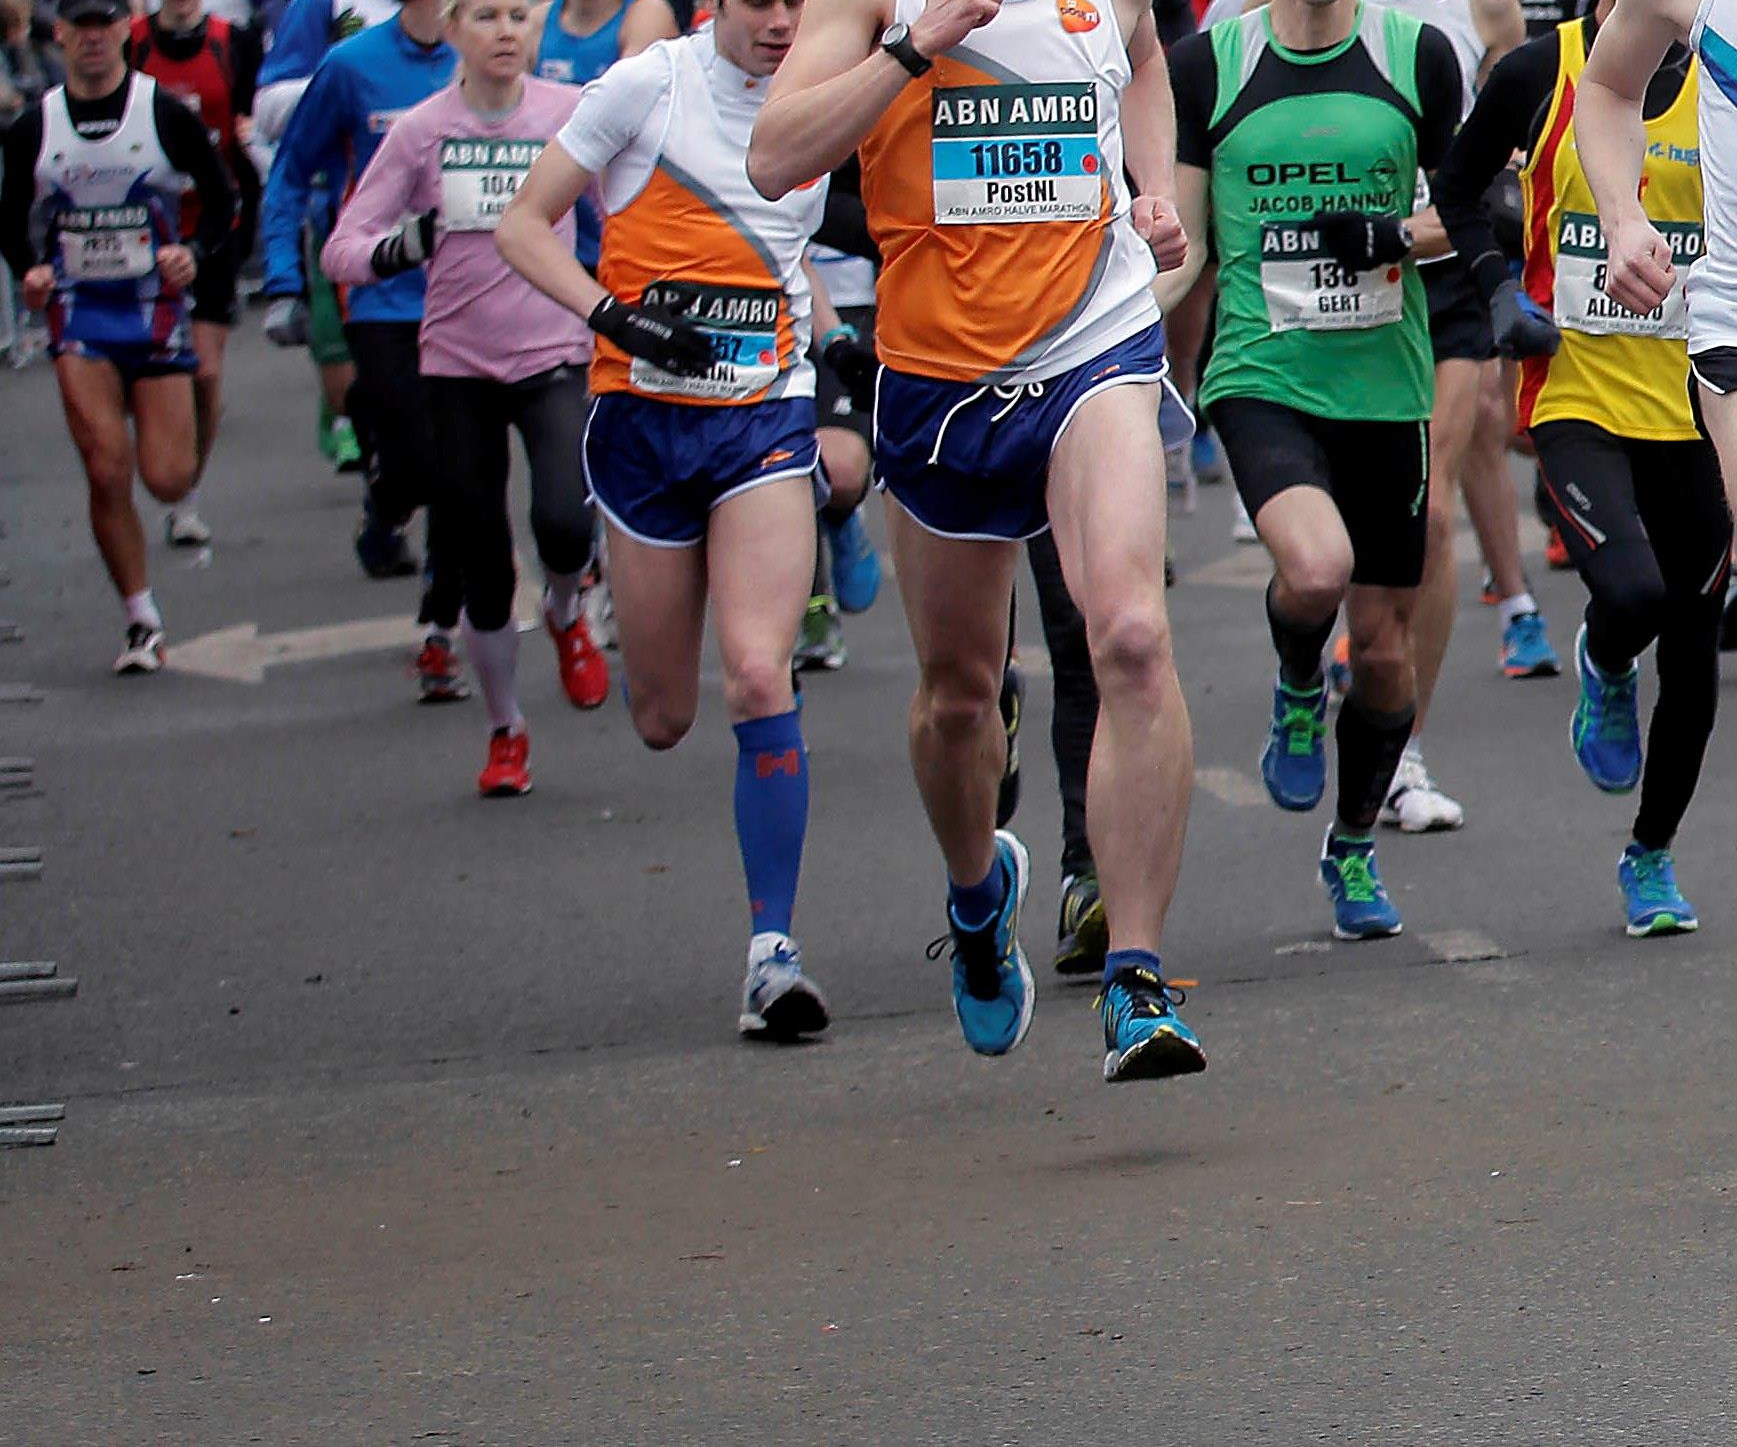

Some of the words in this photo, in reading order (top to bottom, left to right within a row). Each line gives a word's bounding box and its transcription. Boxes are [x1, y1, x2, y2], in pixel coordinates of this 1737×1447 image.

[934, 96, 1000, 126] ABN
[1009, 94, 1095, 124] AMRO
[443, 144, 488, 165] ABN
[493, 143, 544, 164] AMR
[969, 140, 1063, 177] 11658
[479, 174, 522, 194] 104
[1246, 162, 1361, 186] OPEL
[986, 179, 1058, 204] PostNL
[947, 207, 970, 218] ABN
[971, 206, 1003, 217] AMRO
[1004, 205, 1039, 216] HALVE
[1040, 203, 1091, 215] MARATHON
[1250, 194, 1315, 215] JACOB
[1263, 229, 1320, 254] ABN
[1665, 231, 1700, 256] RO
[706, 296, 778, 324] AMRO
[1318, 293, 1361, 314] GERT
